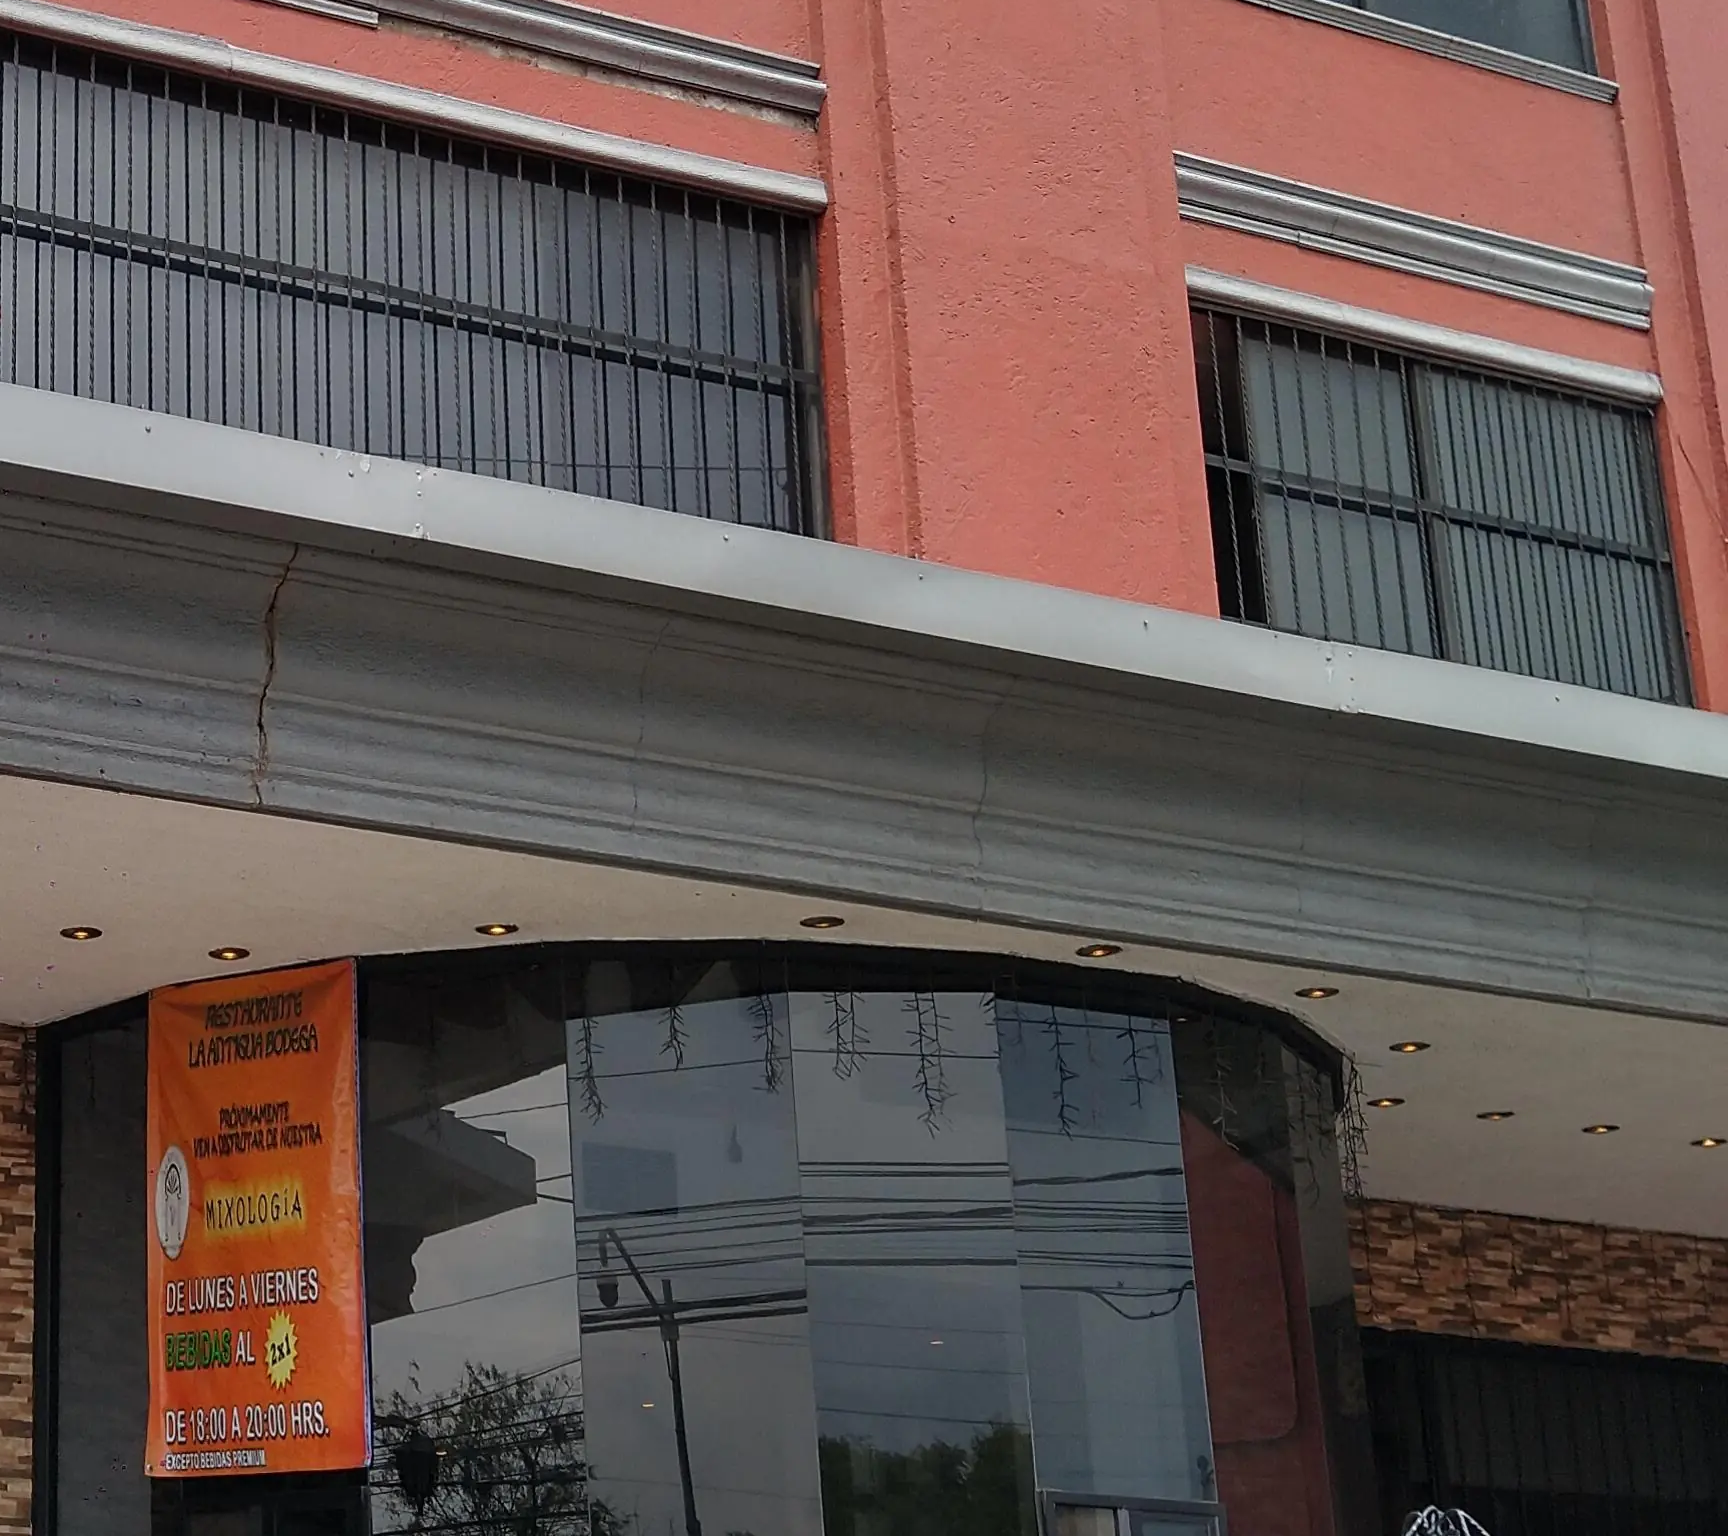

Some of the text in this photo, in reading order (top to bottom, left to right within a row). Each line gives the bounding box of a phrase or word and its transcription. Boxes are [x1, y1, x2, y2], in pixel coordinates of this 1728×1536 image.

[189, 1039, 205, 1068] LA
[266, 1023, 318, 1059] BODEGA
[166, 1267, 319, 1314] DE LUNES A VIERNES
[165, 1329, 291, 1371] BEBIDAS AL 2x1
[166, 1400, 330, 1445] DE 18:00 A 20:00 HRS.
[165, 1448, 267, 1471] EXCEPTO BEBIDAS PREMIUM
